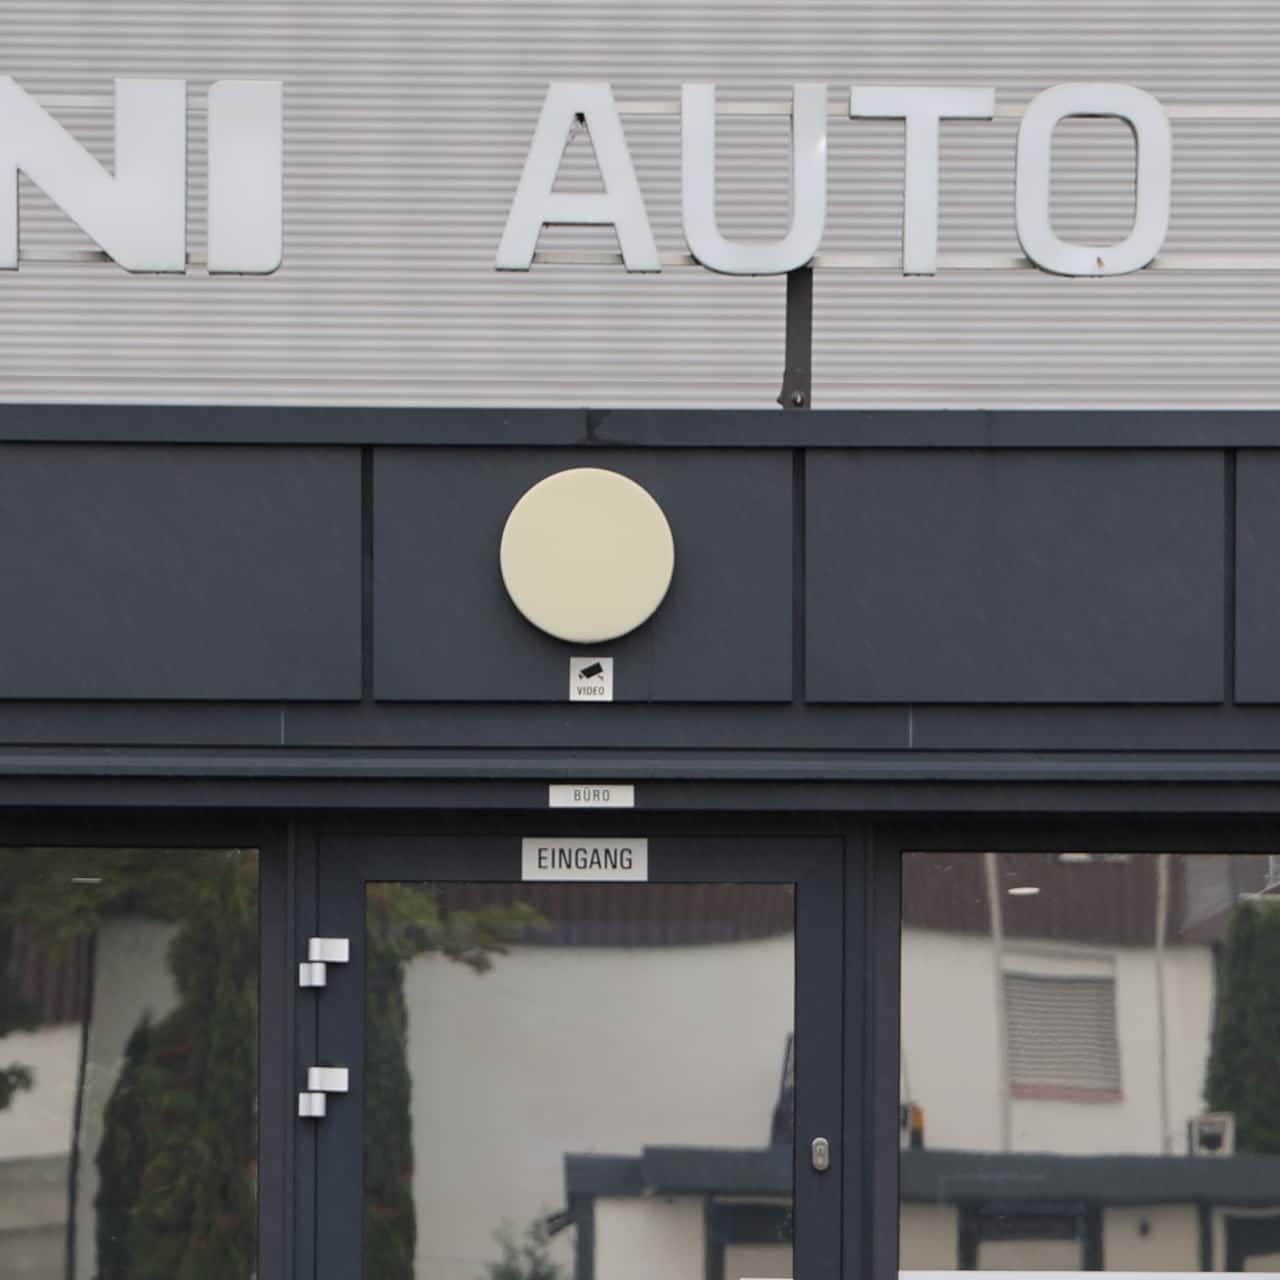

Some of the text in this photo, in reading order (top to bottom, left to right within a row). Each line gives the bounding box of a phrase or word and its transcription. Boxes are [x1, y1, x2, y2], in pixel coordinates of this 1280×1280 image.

[495, 82, 1172, 277] AUTO
[576, 686, 605, 696] VIDEO
[573, 786, 610, 801] BÜRO
[537, 847, 633, 870] EINGANG
